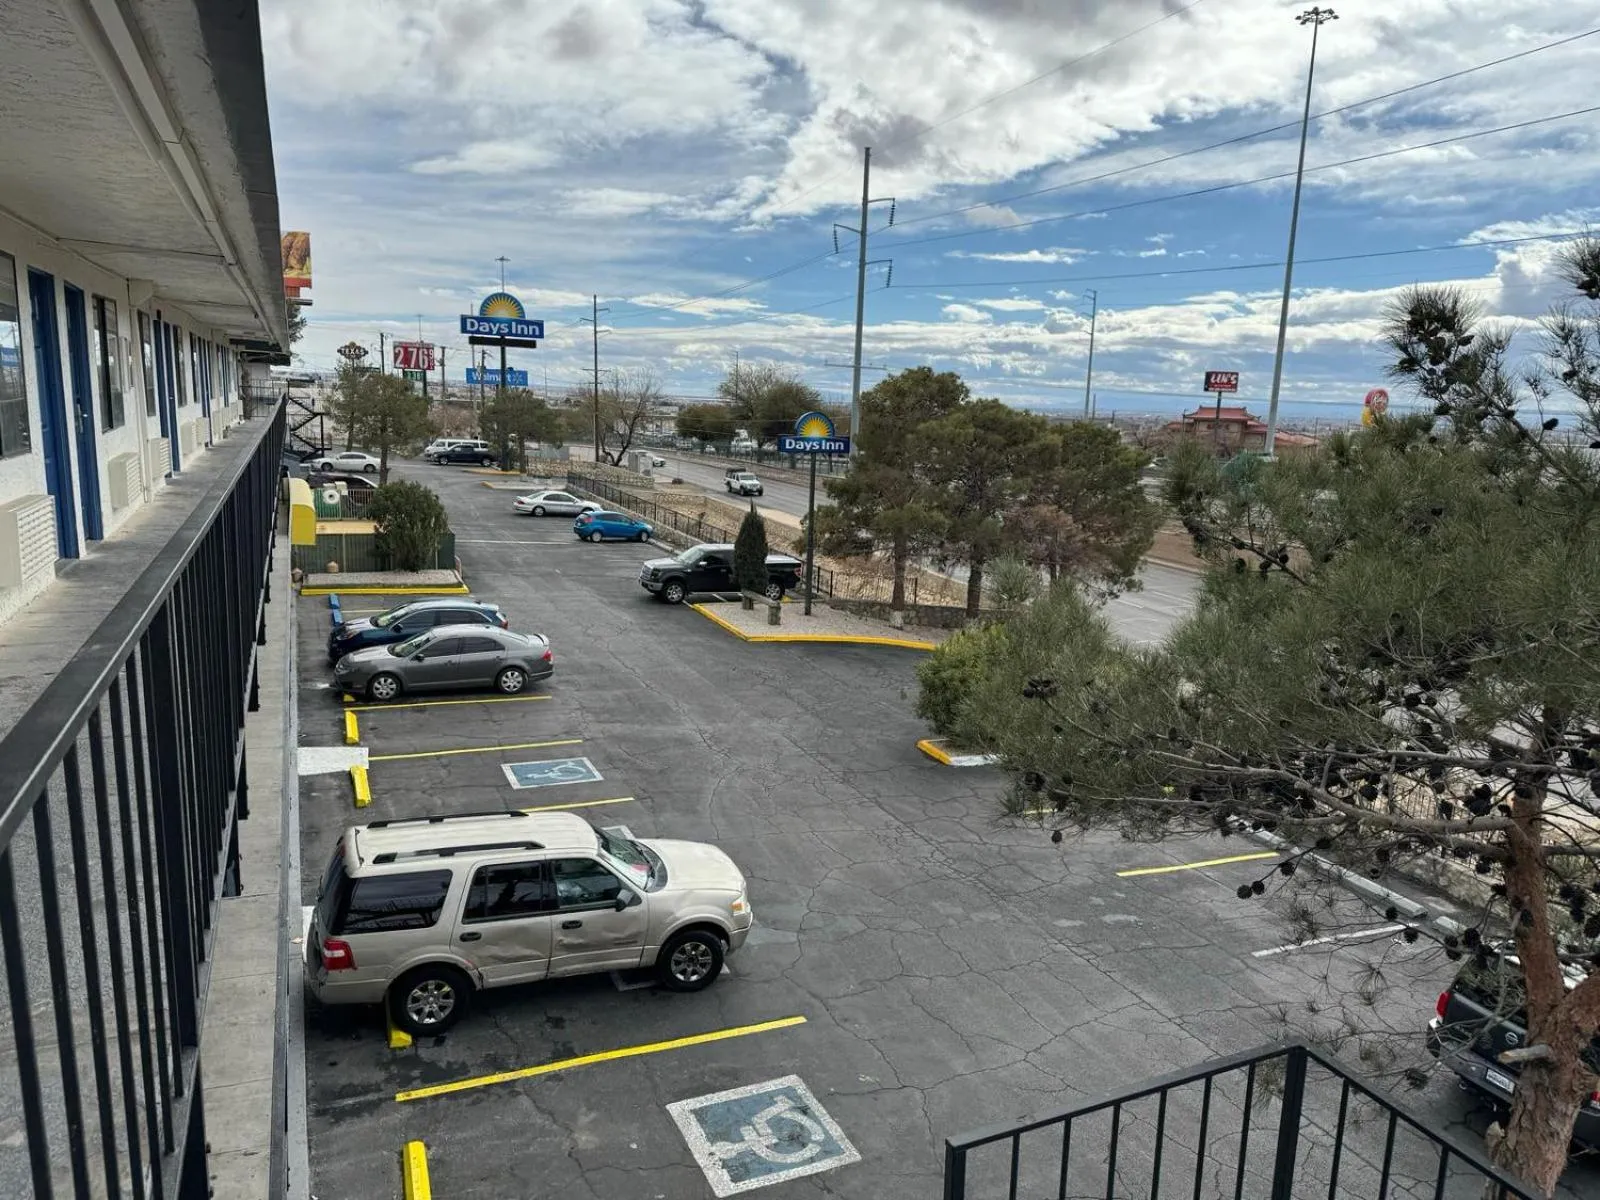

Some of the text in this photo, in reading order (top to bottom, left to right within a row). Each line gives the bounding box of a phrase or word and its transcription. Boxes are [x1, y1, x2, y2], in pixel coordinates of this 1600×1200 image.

[466, 318, 540, 336] Days Inn
[472, 371, 512, 382] Wlmt
[785, 439, 844, 451] Days Inn
